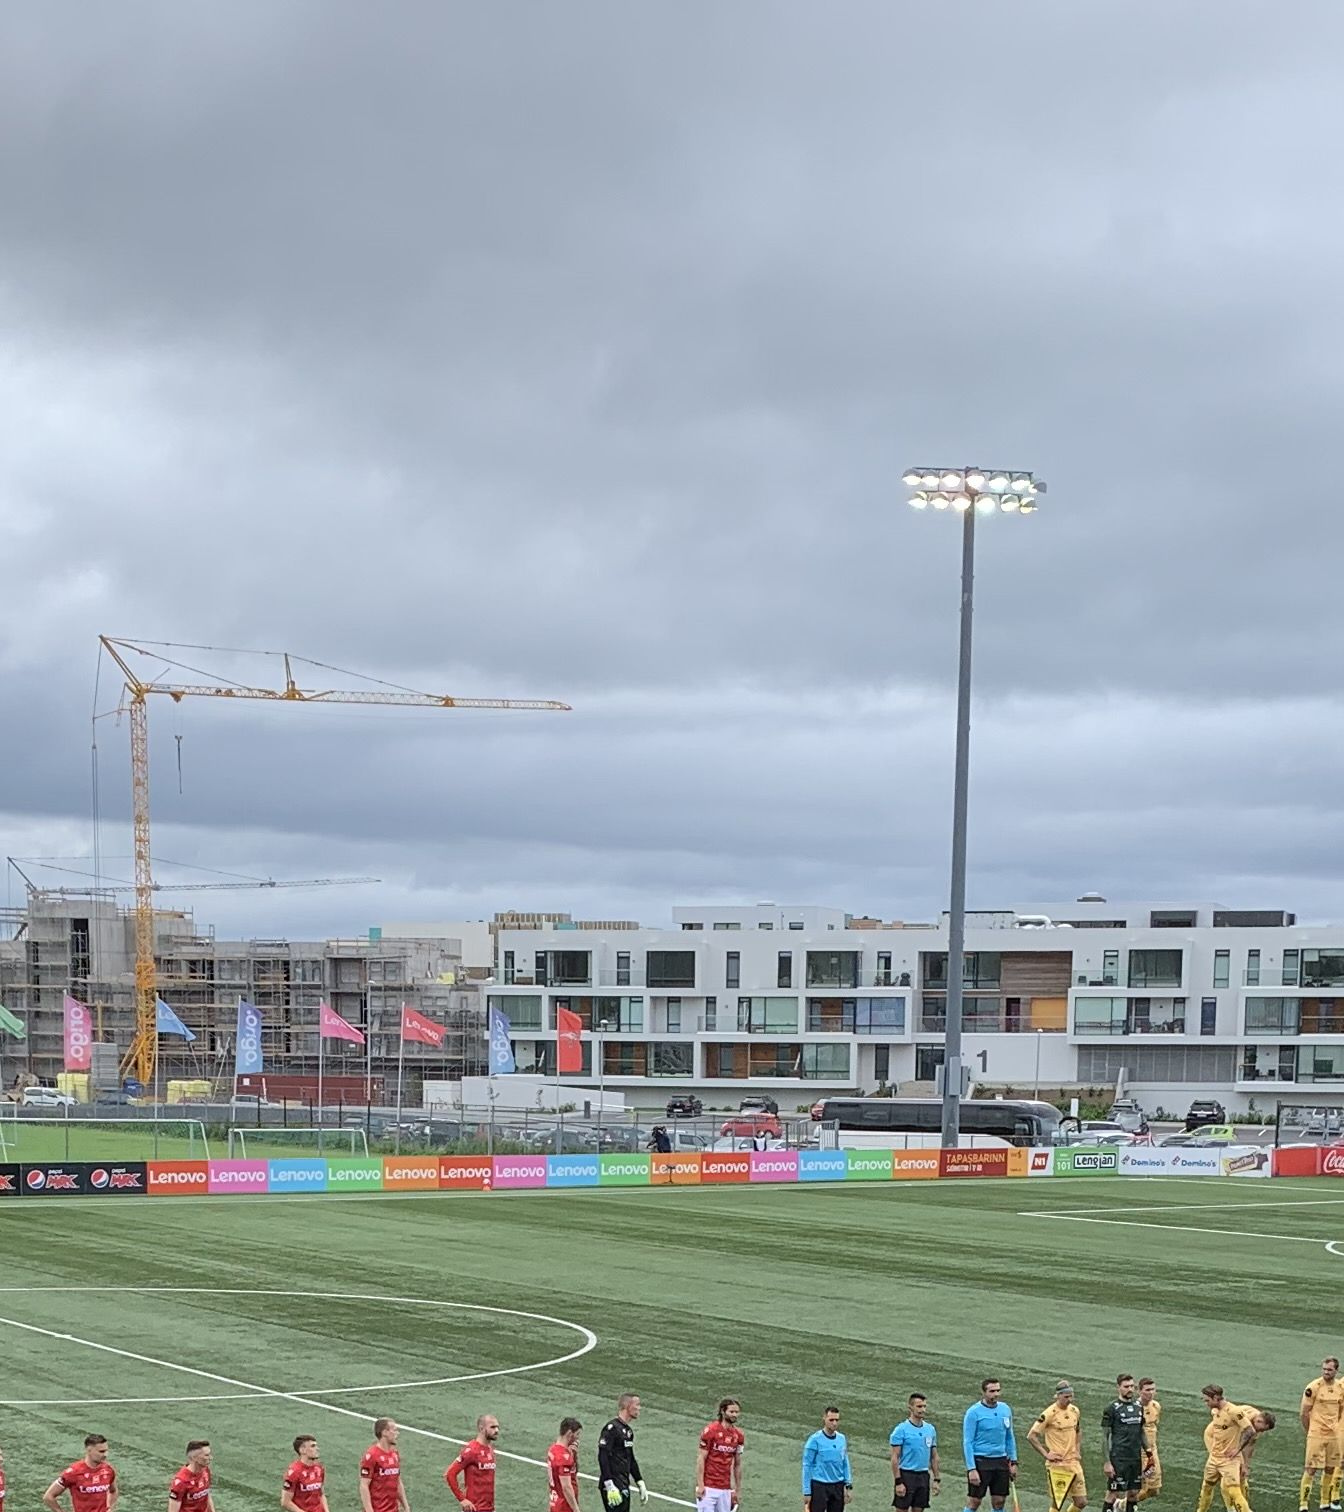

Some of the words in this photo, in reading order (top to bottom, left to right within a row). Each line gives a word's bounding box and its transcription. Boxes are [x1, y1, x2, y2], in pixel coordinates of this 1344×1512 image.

[976, 1049, 988, 1073] 1
[751, 1159, 797, 1173] Lenovo
[847, 1159, 892, 1172] Lenovo
[894, 1157, 938, 1171] Lenovo
[946, 1153, 1005, 1165] TAPASBARINN
[1034, 1158, 1046, 1167] N1
[1056, 1161, 1071, 1171] 101
[1075, 1155, 1114, 1168] Lengjan
[1130, 1158, 1165, 1168] Domino's
[1181, 1158, 1216, 1168] Domino's
[385, 1166, 437, 1181] Lenovo
[440, 1165, 492, 1179] Lenovo
[495, 1164, 545, 1178] Lenovo
[549, 1165, 598, 1178] Lenovo
[600, 1163, 649, 1177] Lenovo
[702, 1160, 749, 1174] Lenovo
[800, 1160, 845, 1173] Lenovo
[149, 1169, 207, 1184] Lenovo
[211, 1168, 266, 1183] Lenovo
[270, 1167, 324, 1182] Lenovo
[329, 1167, 381, 1182] Lenovo
